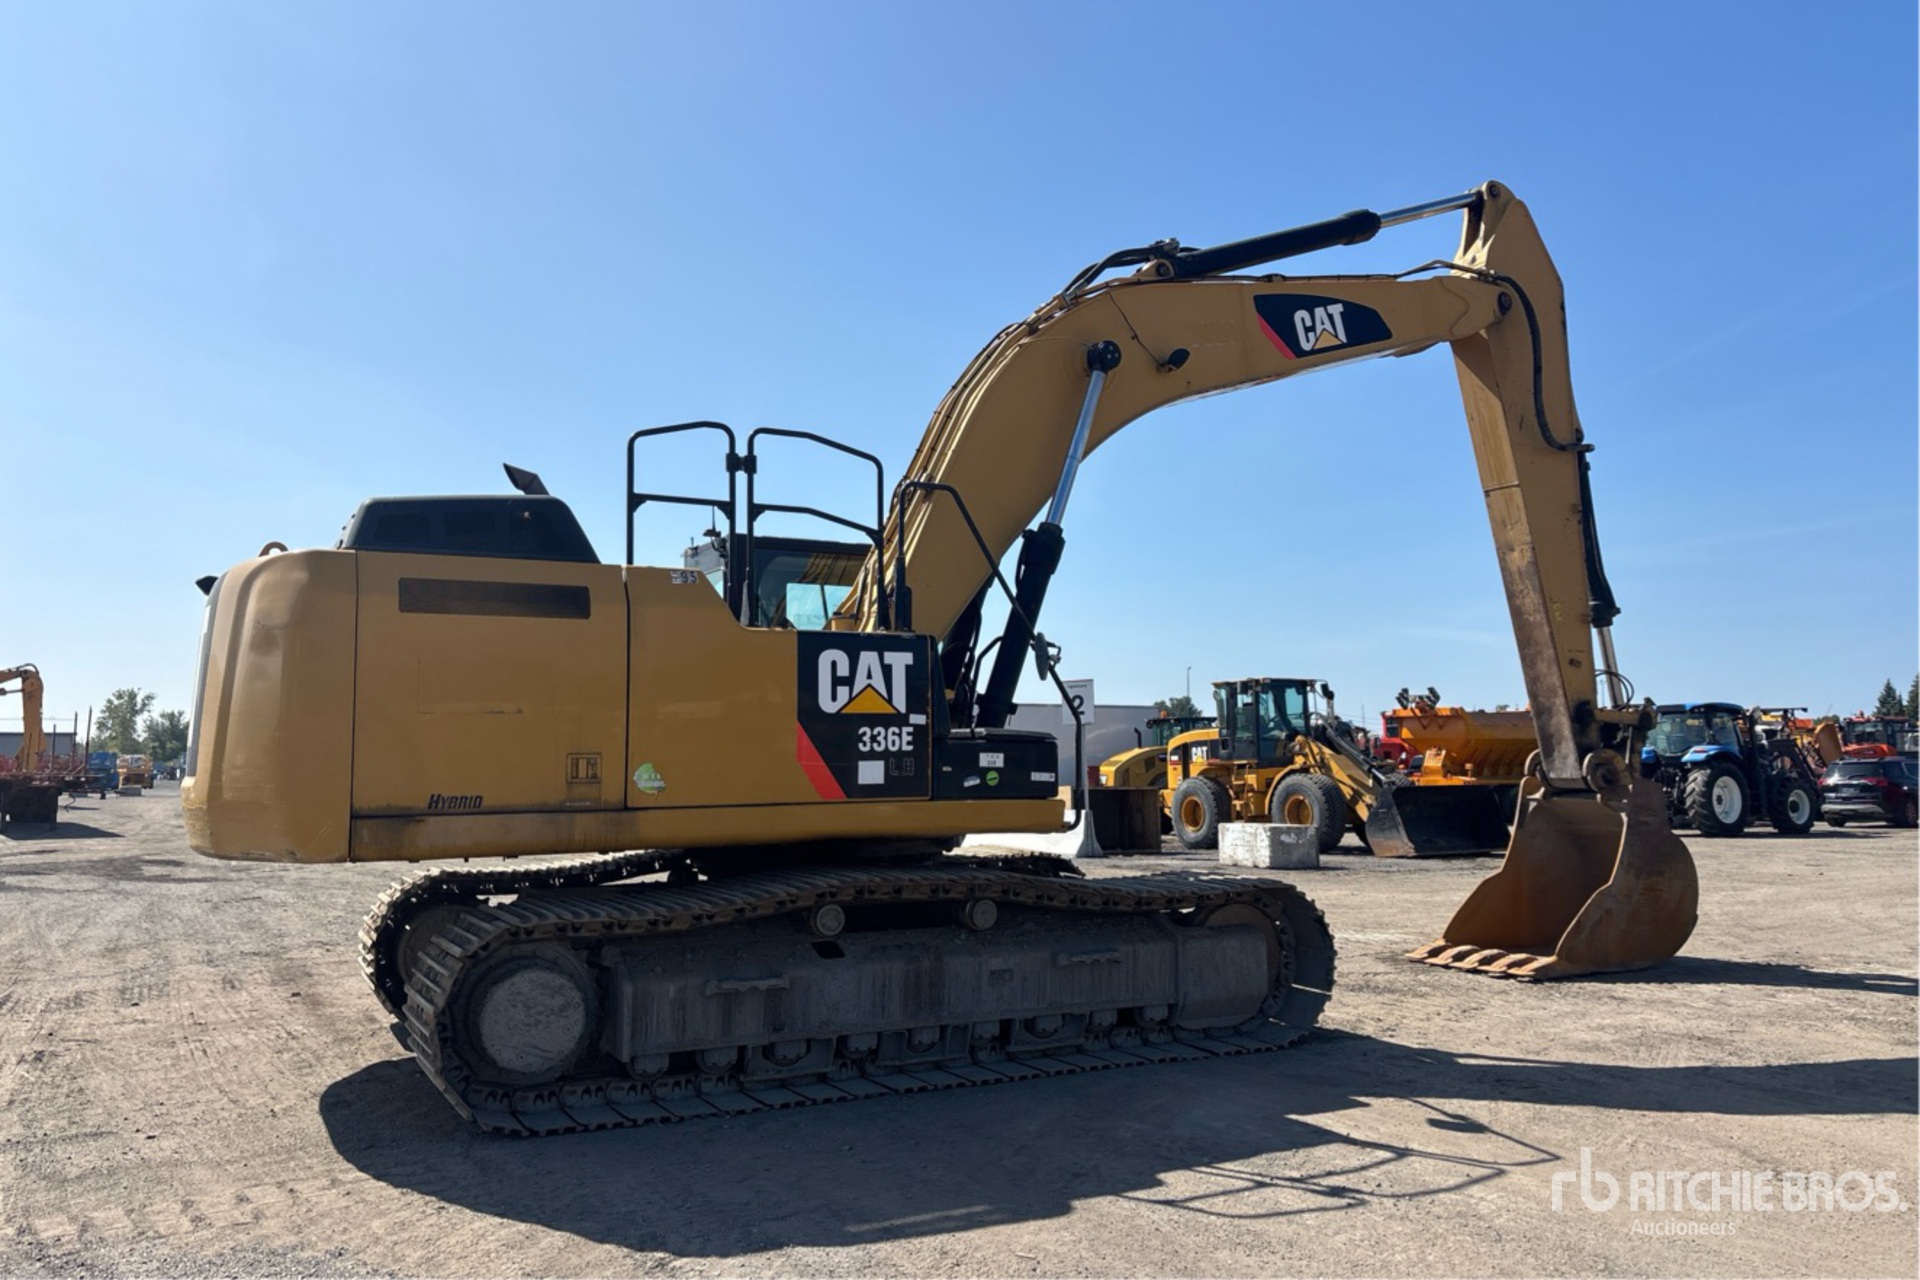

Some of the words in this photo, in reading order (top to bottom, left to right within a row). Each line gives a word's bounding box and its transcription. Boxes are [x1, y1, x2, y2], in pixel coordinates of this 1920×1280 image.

[1294, 303, 1347, 351] CAT
[818, 649, 914, 714] CAT
[858, 726, 914, 752] 336E
[1191, 746, 1208, 763] CAT
[428, 794, 483, 810] HYBRID
